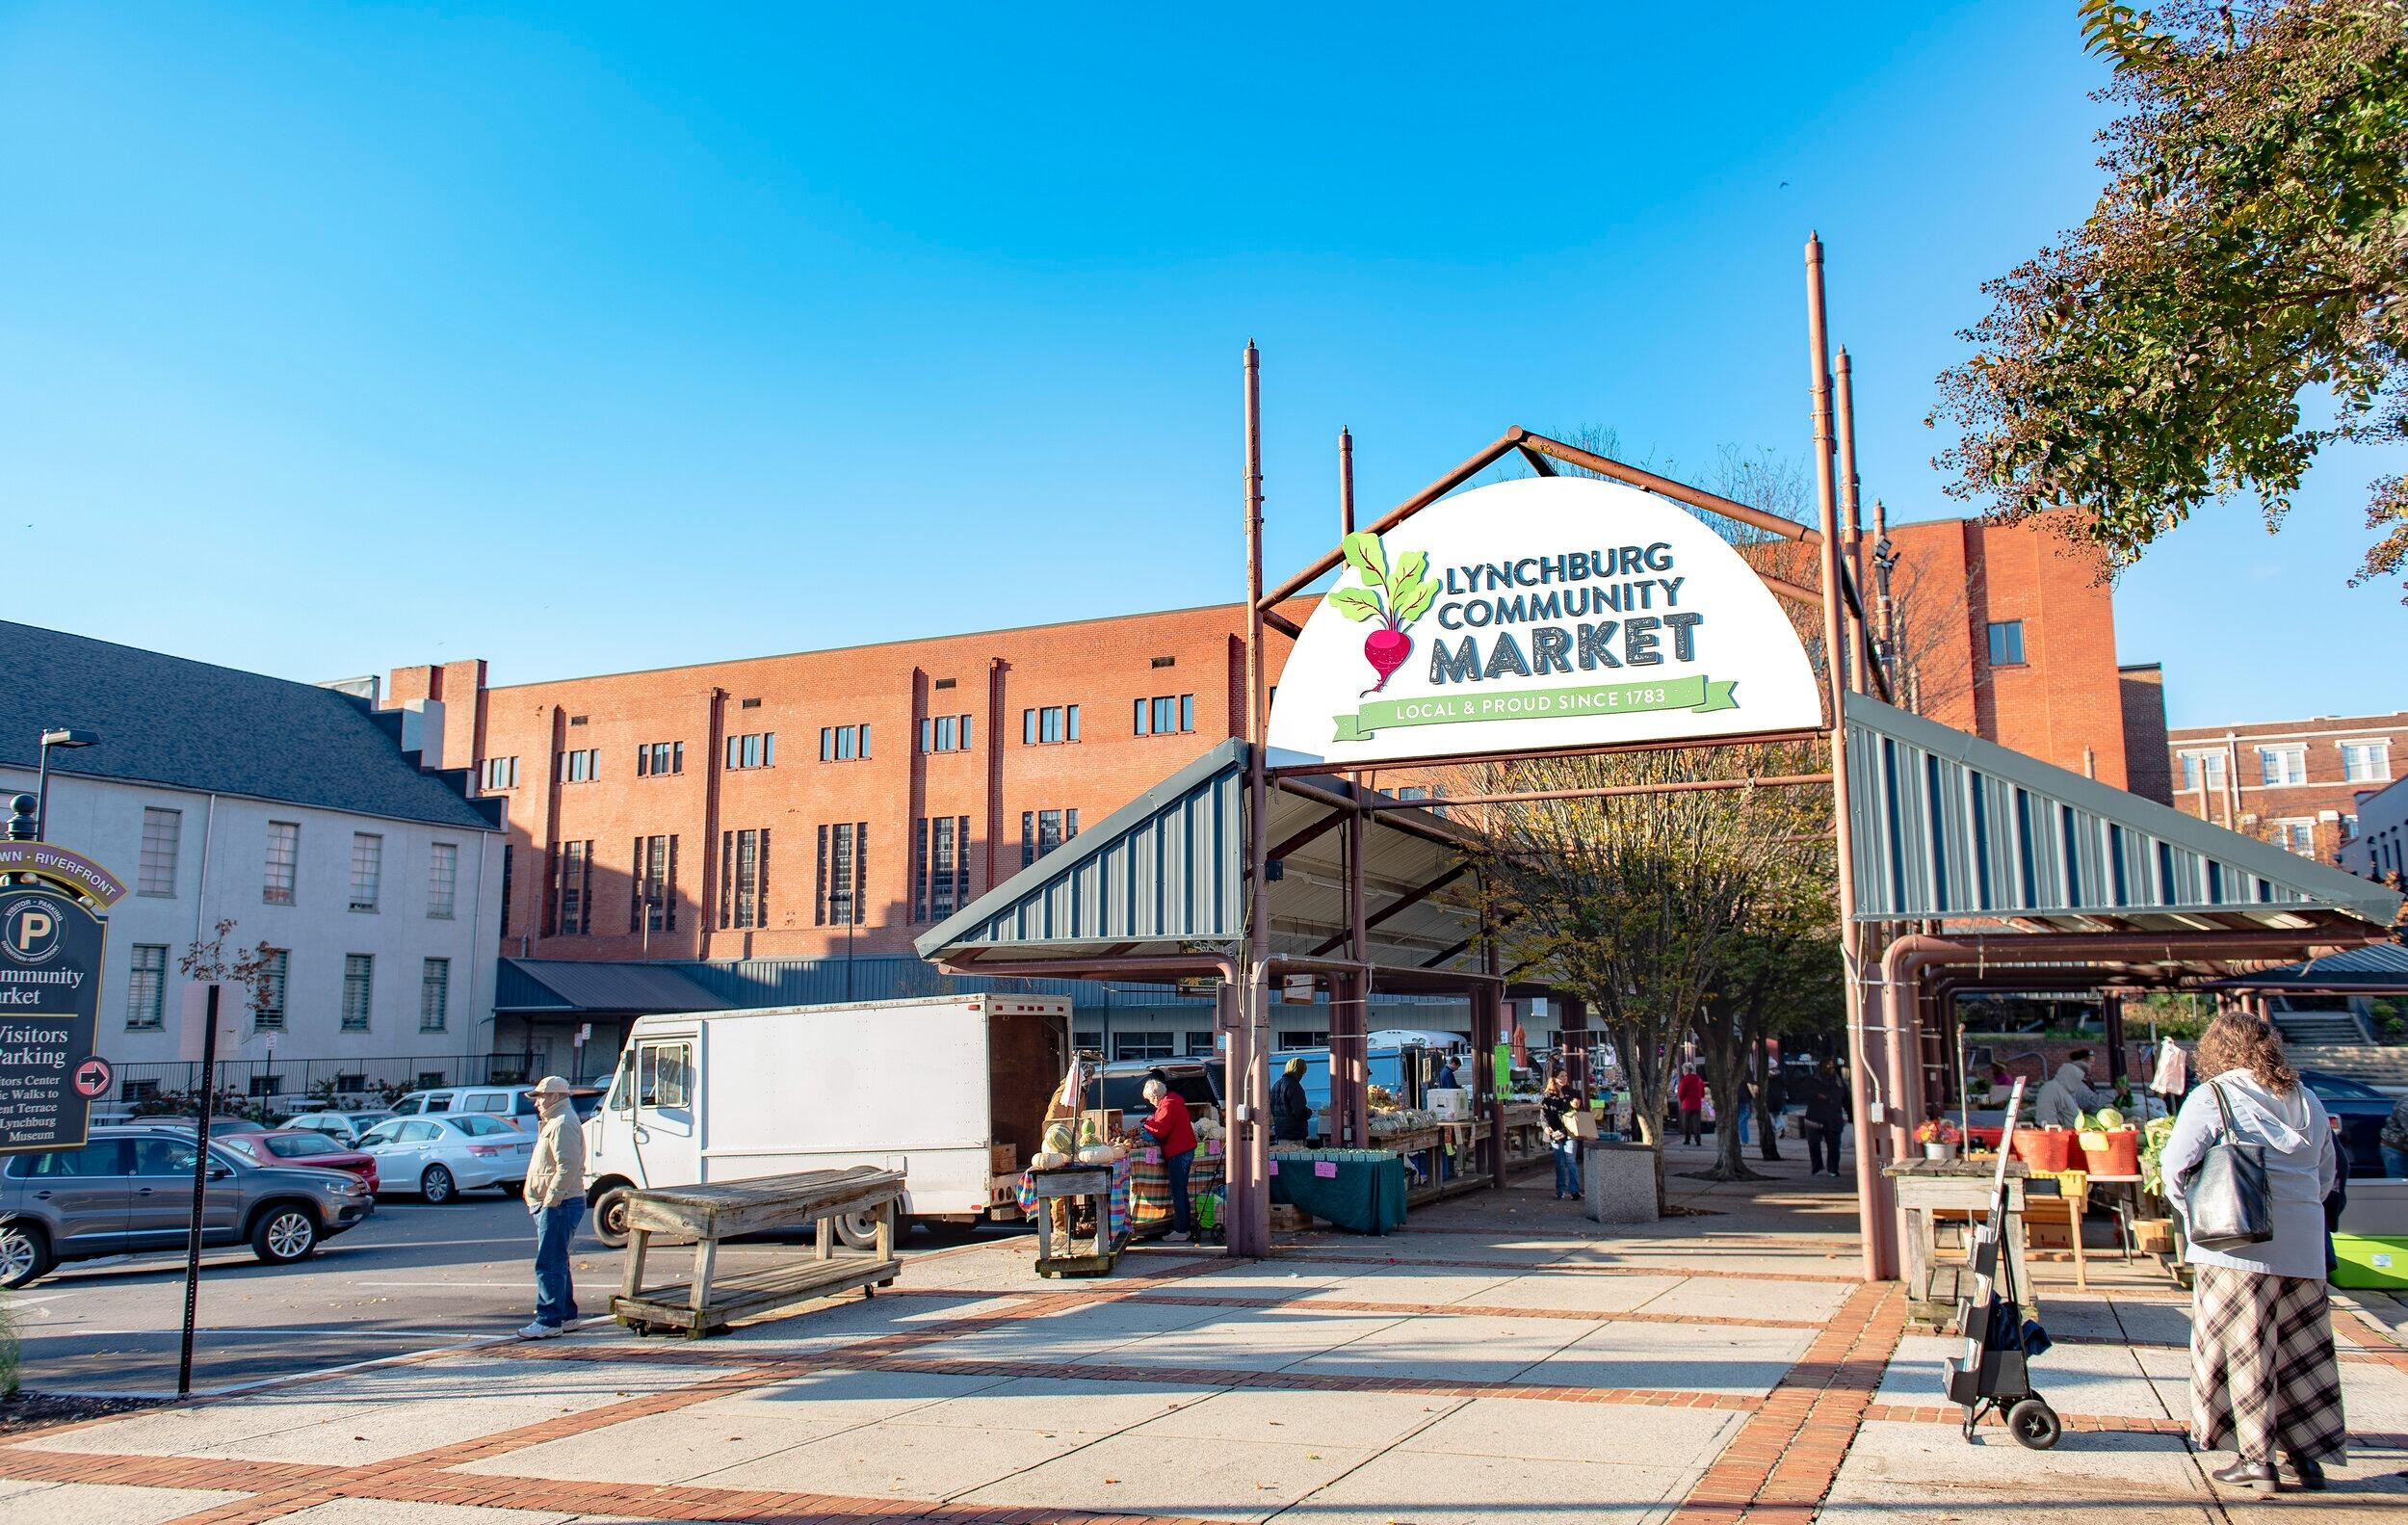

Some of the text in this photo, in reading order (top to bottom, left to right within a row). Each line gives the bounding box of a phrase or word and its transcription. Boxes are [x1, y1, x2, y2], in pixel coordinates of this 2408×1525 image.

[1446, 541, 1674, 595] LYNCHBURG
[1437, 576, 1686, 630] COMMUNITY
[1429, 612, 1703, 685] MARKET
[1397, 688, 1665, 721] LOCAL & PROUD SINCE 1783
[35, 853, 117, 897] RIVERFRONT
[5, 899, 64, 922] VISITOR PARKING
[19, 912, 52, 950] P
[0, 986, 41, 1005] rket
[0, 1046, 66, 1068] arking
[24, 1075, 61, 1086] Center
[12, 1089, 46, 1099] Walks
[47, 1090, 59, 1098] to
[16, 1103, 58, 1114] Terrace
[0, 1117, 57, 1131] Lynchburg
[8, 1130, 55, 1142] Museum
